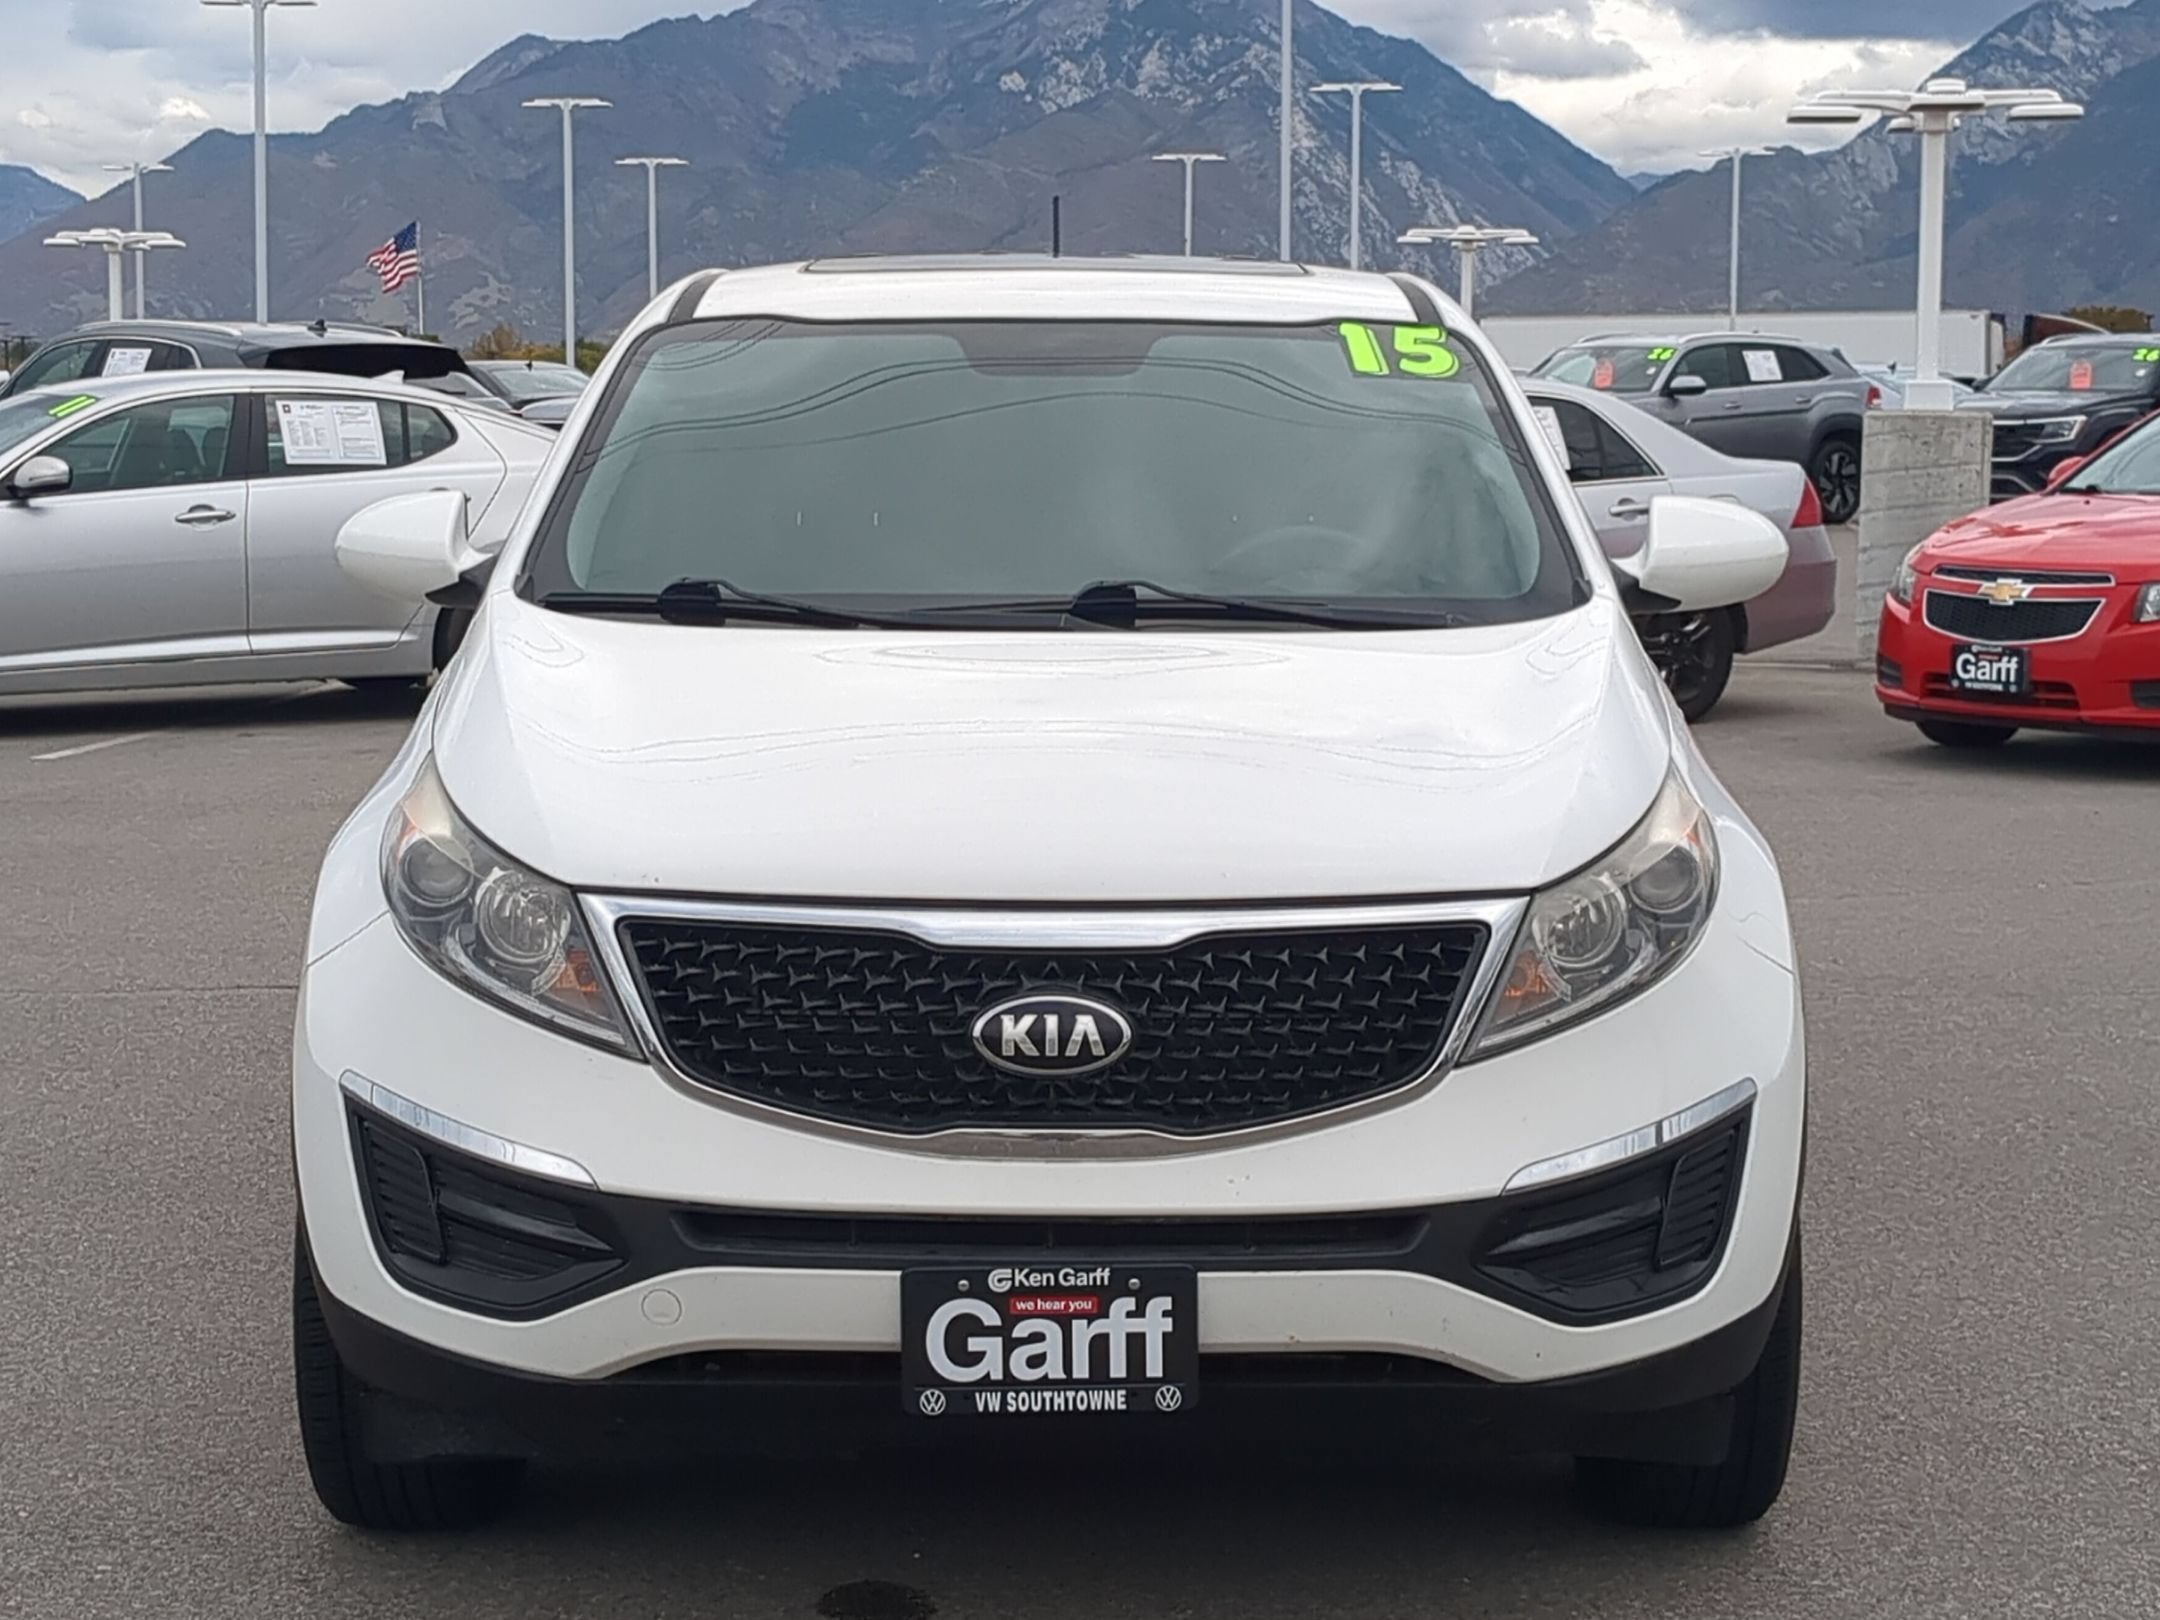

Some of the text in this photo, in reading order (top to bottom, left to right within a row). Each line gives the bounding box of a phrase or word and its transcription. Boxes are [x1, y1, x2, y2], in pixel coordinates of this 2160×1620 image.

[1338, 322, 1460, 378] 15
[1956, 652, 2018, 683] Garff
[1000, 1014, 1106, 1057] KIA
[1014, 1267, 1110, 1287] Ken Garff
[1016, 1298, 1092, 1312] we hear you
[925, 1296, 1173, 1383] Garff
[975, 1389, 1127, 1412] VW SOUTHTOWNE
